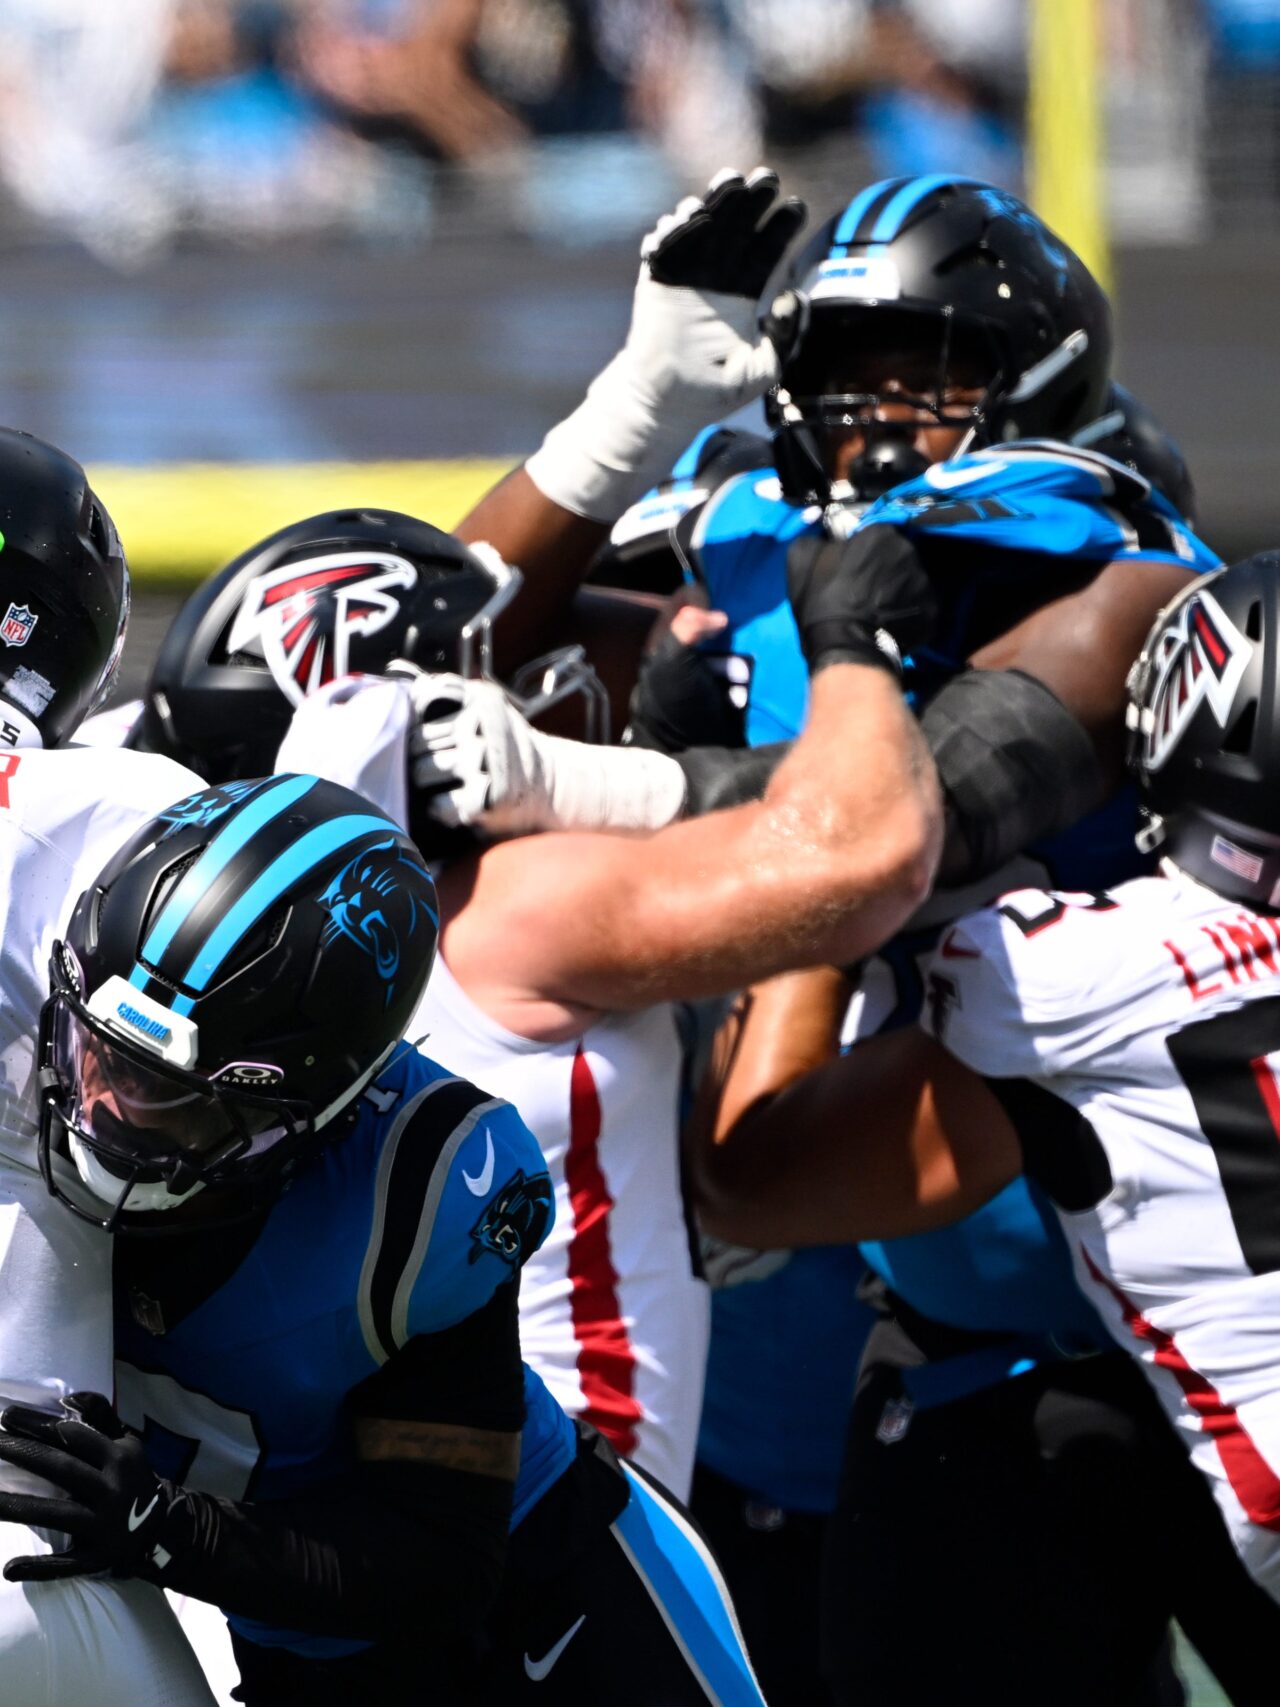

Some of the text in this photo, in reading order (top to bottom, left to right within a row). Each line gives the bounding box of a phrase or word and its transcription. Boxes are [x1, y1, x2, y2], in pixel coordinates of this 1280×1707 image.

[3, 618, 26, 641] NFL
[1163, 913, 1280, 1003] LIN
[116, 1001, 170, 1041] CAROLINA
[221, 1075, 279, 1085] OAKLEY
